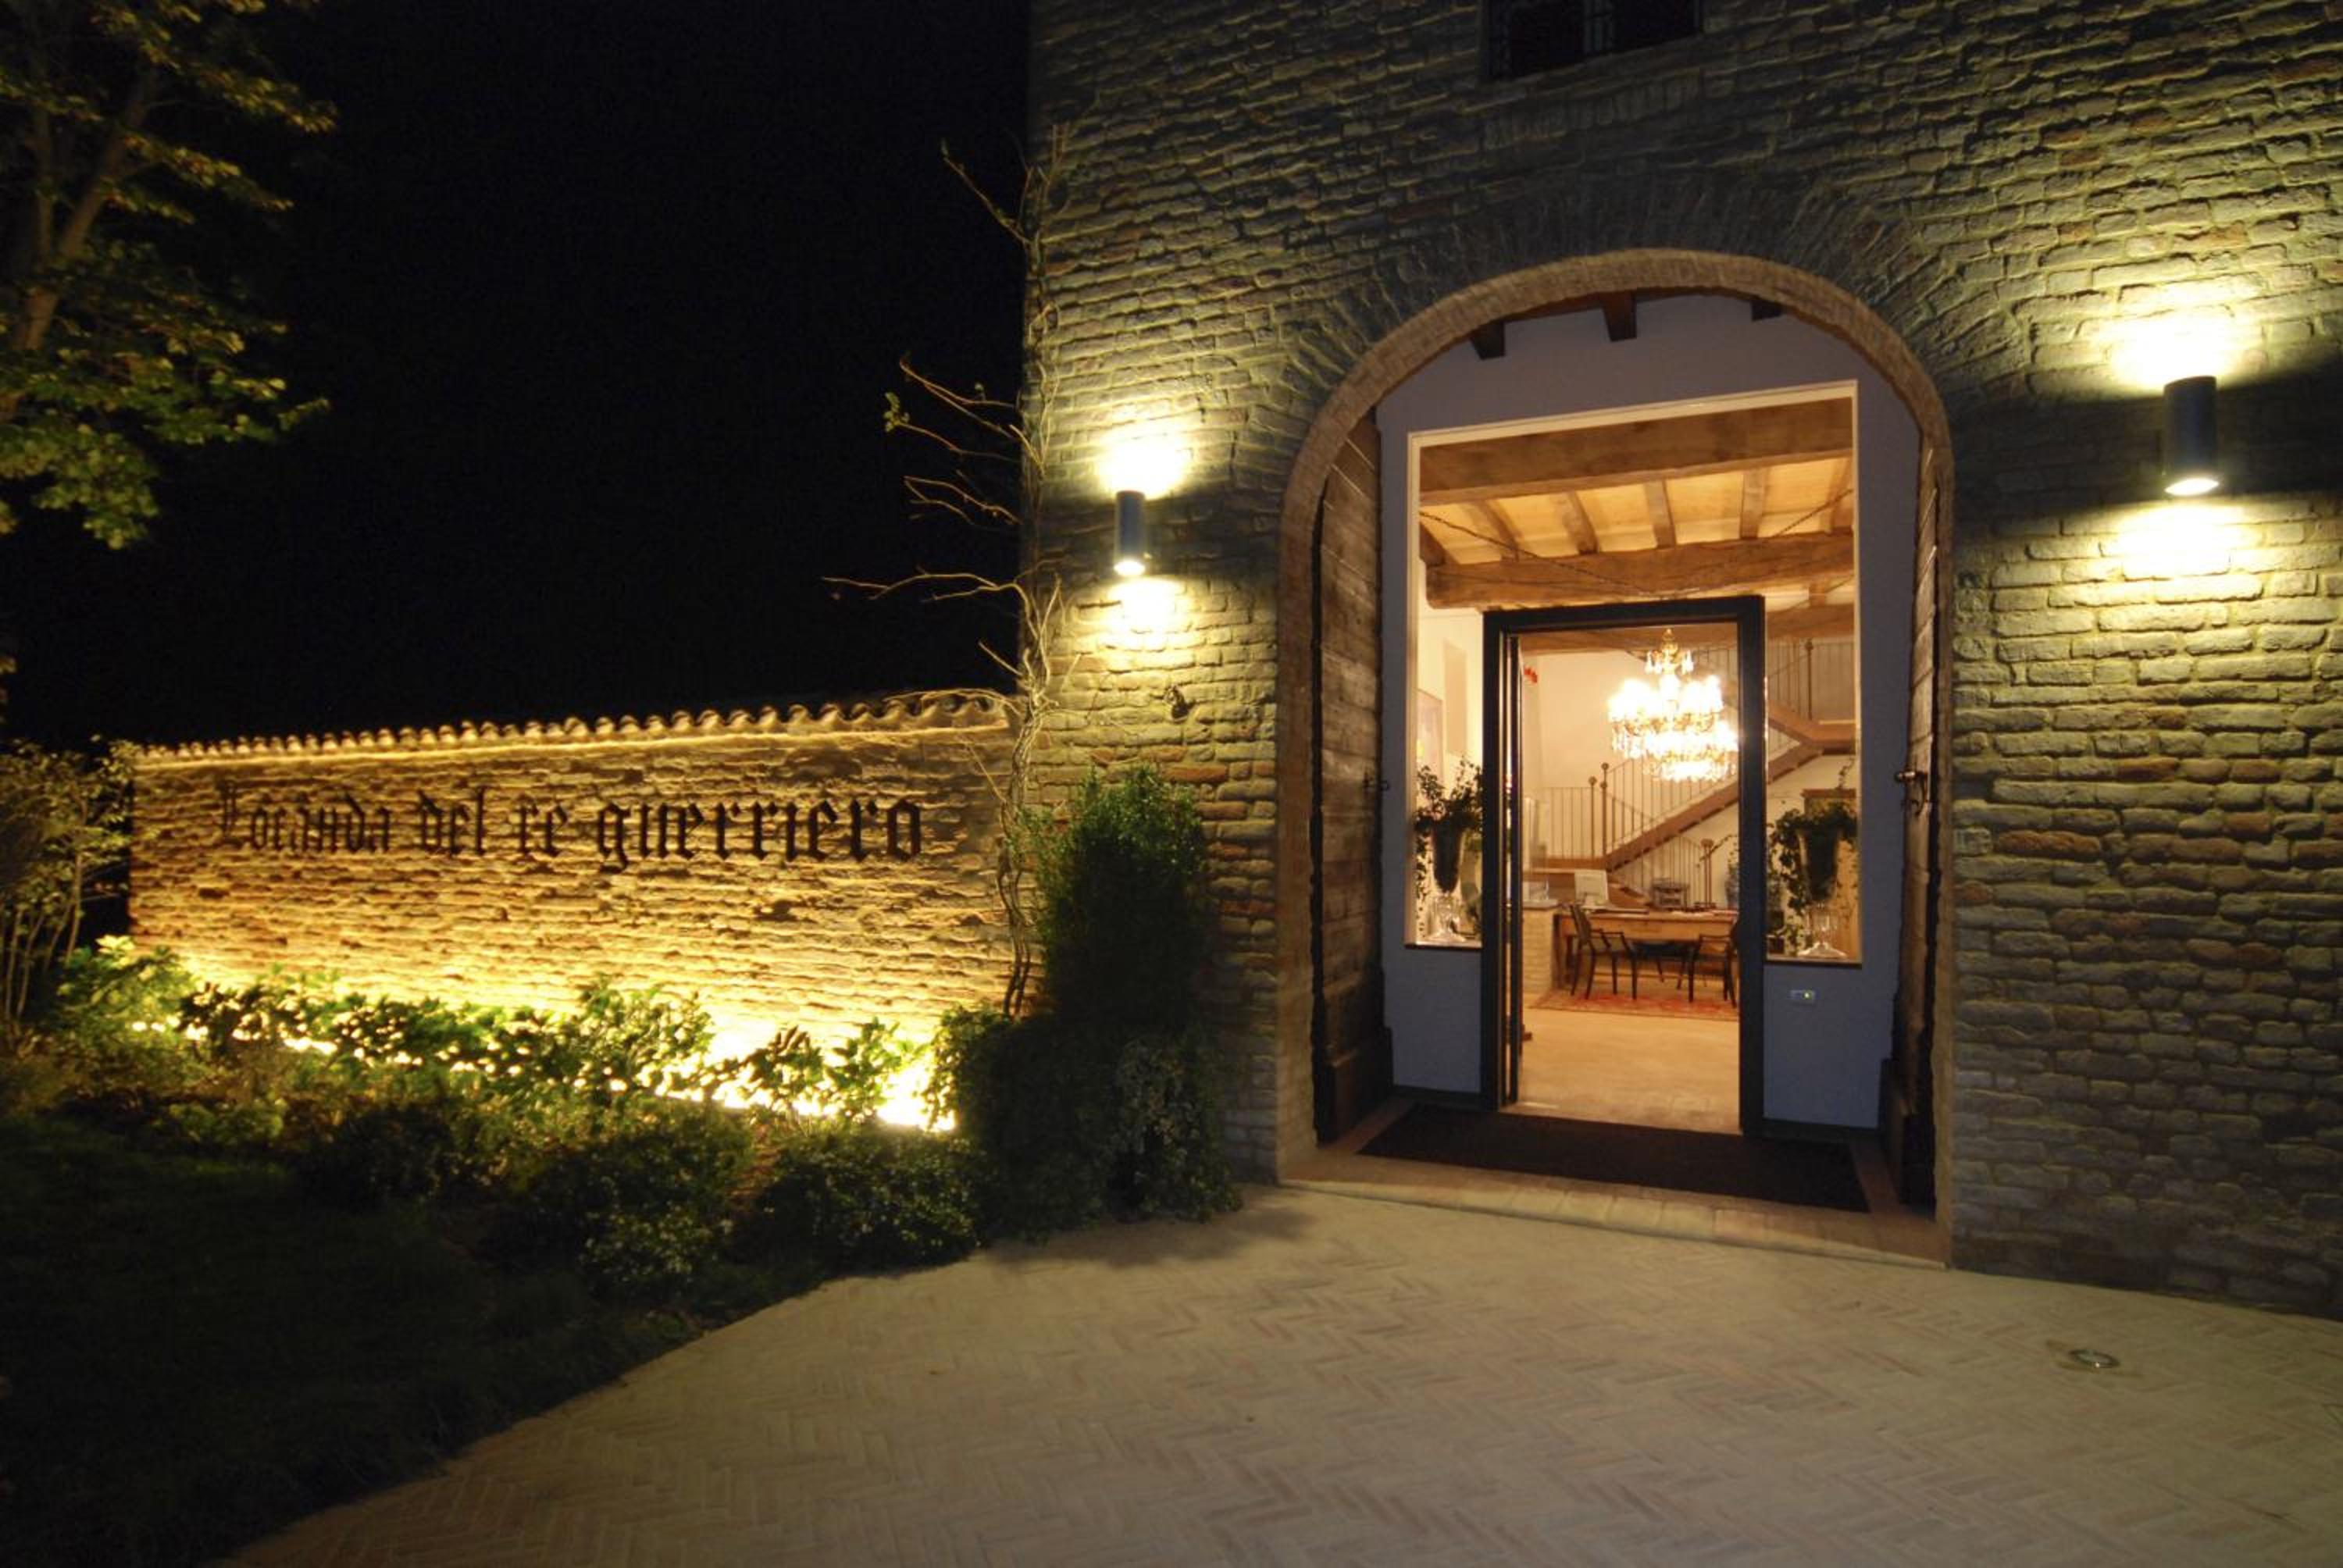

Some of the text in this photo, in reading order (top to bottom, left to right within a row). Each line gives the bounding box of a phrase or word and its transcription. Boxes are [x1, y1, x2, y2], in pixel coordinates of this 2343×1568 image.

[417, 787, 486, 857] del
[519, 796, 568, 857] re
[597, 800, 922, 875] guerriero
